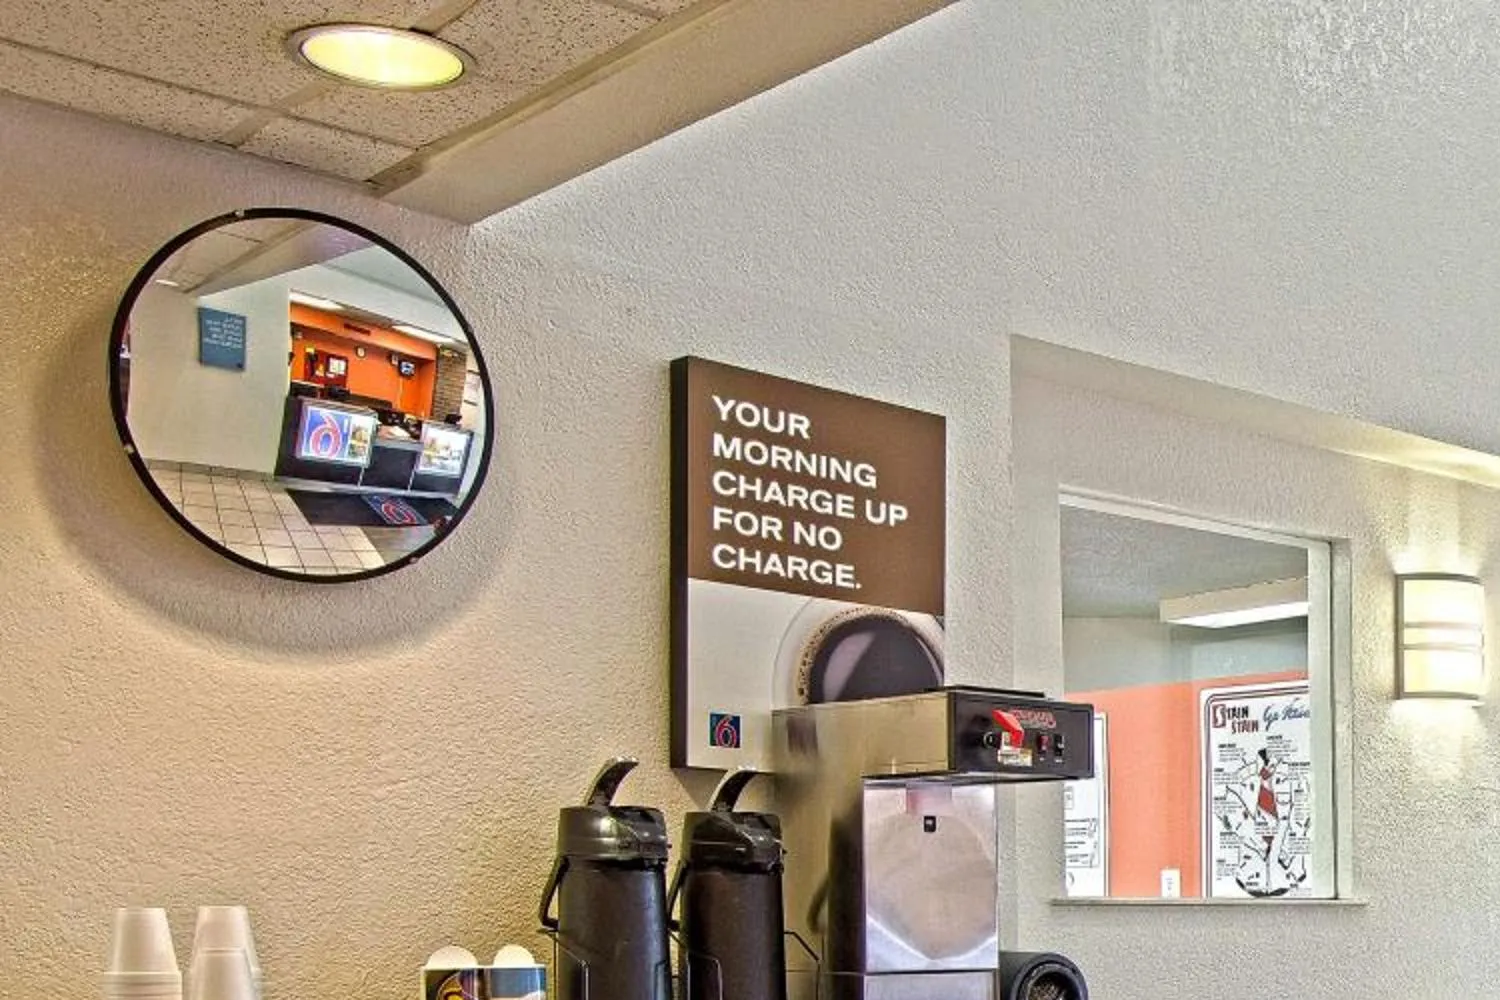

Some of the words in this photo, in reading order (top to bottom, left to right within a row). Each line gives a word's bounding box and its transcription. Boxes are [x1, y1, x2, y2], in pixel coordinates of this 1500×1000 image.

[712, 395, 811, 439] YOUR
[712, 433, 878, 489] MORNING
[712, 470, 856, 519] CHARGE
[865, 499, 909, 527] UP
[712, 505, 784, 541] FOR
[793, 521, 843, 550] NO
[712, 543, 863, 589] CHARGE.
